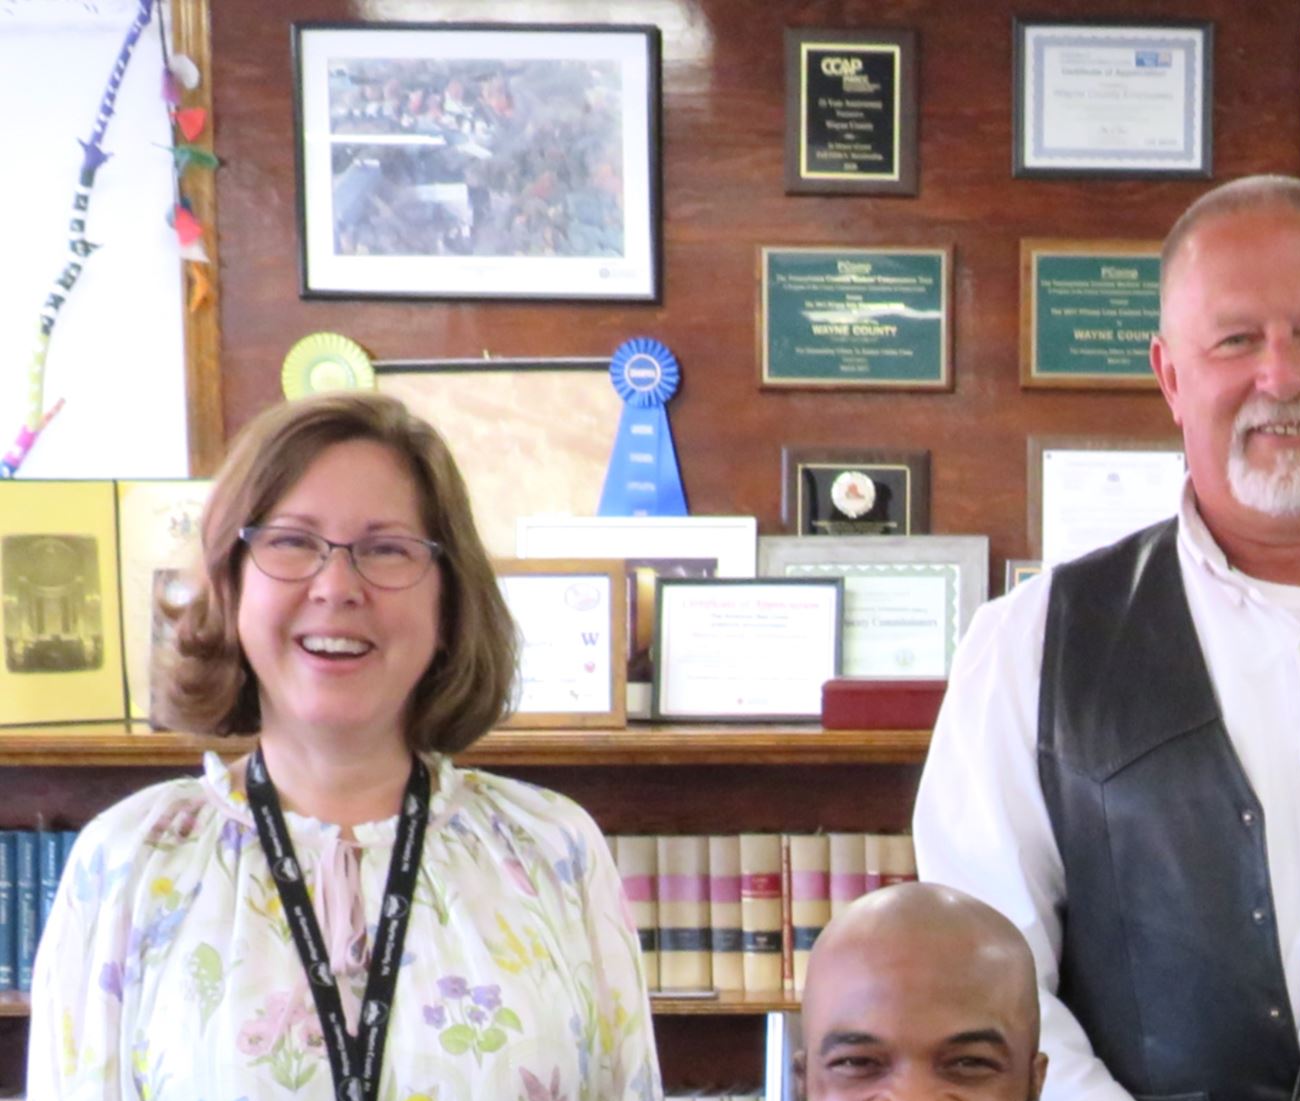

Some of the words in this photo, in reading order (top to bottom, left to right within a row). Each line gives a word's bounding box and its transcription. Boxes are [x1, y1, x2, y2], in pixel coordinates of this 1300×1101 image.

[820, 57, 863, 76] CCAP
[811, 324, 849, 336] WAYNE
[852, 325, 897, 337] COUNTY
[1073, 330, 1113, 341] WAYNE
[580, 631, 600, 646] W
